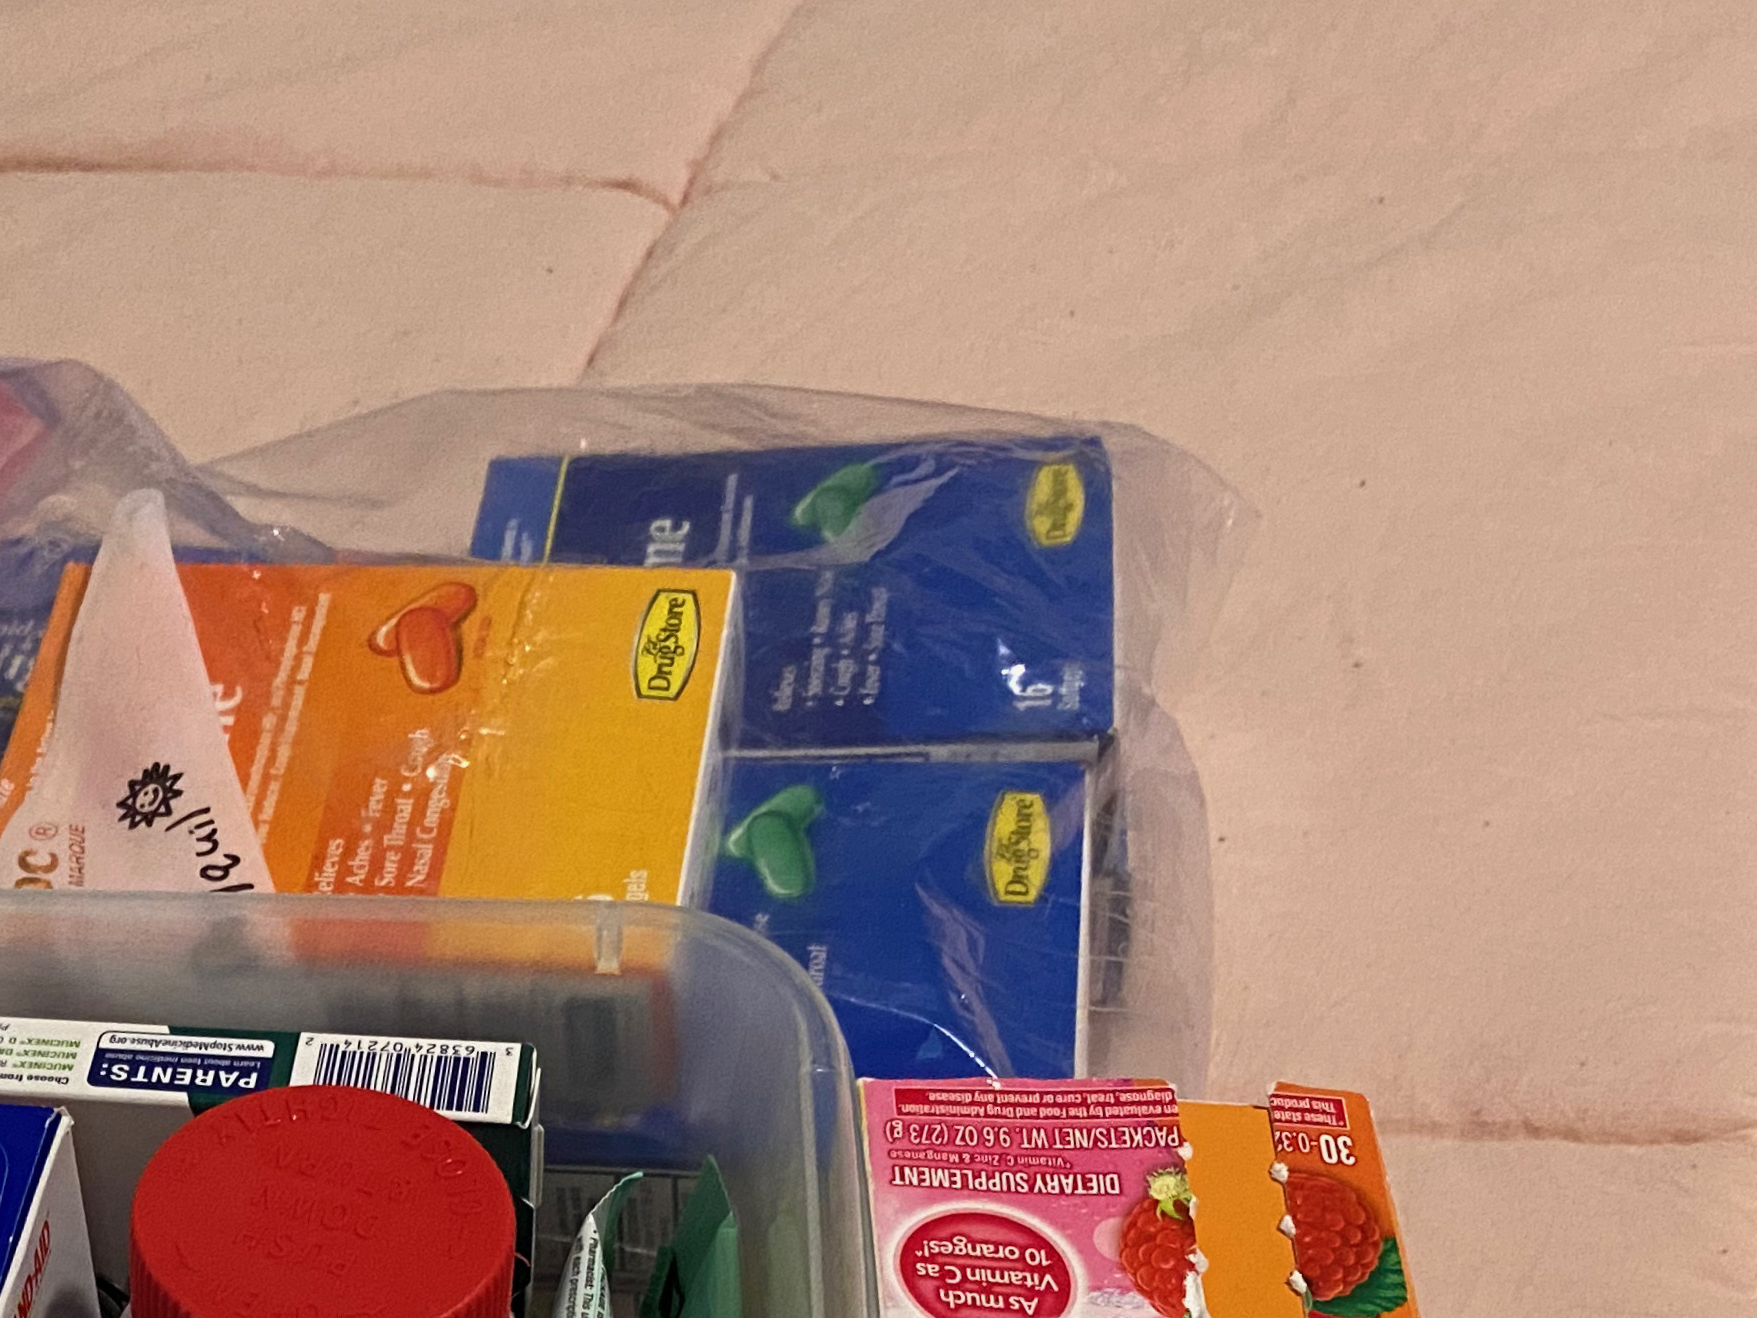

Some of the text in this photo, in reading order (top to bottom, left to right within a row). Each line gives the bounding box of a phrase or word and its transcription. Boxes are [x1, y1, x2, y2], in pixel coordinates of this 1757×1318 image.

[384, 798, 413, 853] Throat
[68, 823, 86, 887] MARQUE
[346, 838, 373, 887] Aches
[405, 841, 433, 888] Nasal
[375, 852, 398, 888] Sore
[343, 1038, 476, 1056] 63824 07214
[26, 1074, 70, 1085] Choose
[99, 1063, 258, 1089] PARENTS:
[986, 1103, 1160, 1119] evaluated by the Food and Drug
[996, 1092, 1040, 1106] prevent
[884, 1119, 1180, 1149] PACKETS/NET 9.6 OZ (273 g)
[887, 1150, 959, 1164] Manganese
[892, 1165, 1121, 1195] DIETARY SUPPLEMENT
[1024, 1247, 1052, 1267] 10
[914, 1260, 1059, 1293] Vitamin C as
[938, 1288, 1039, 1316] As much
